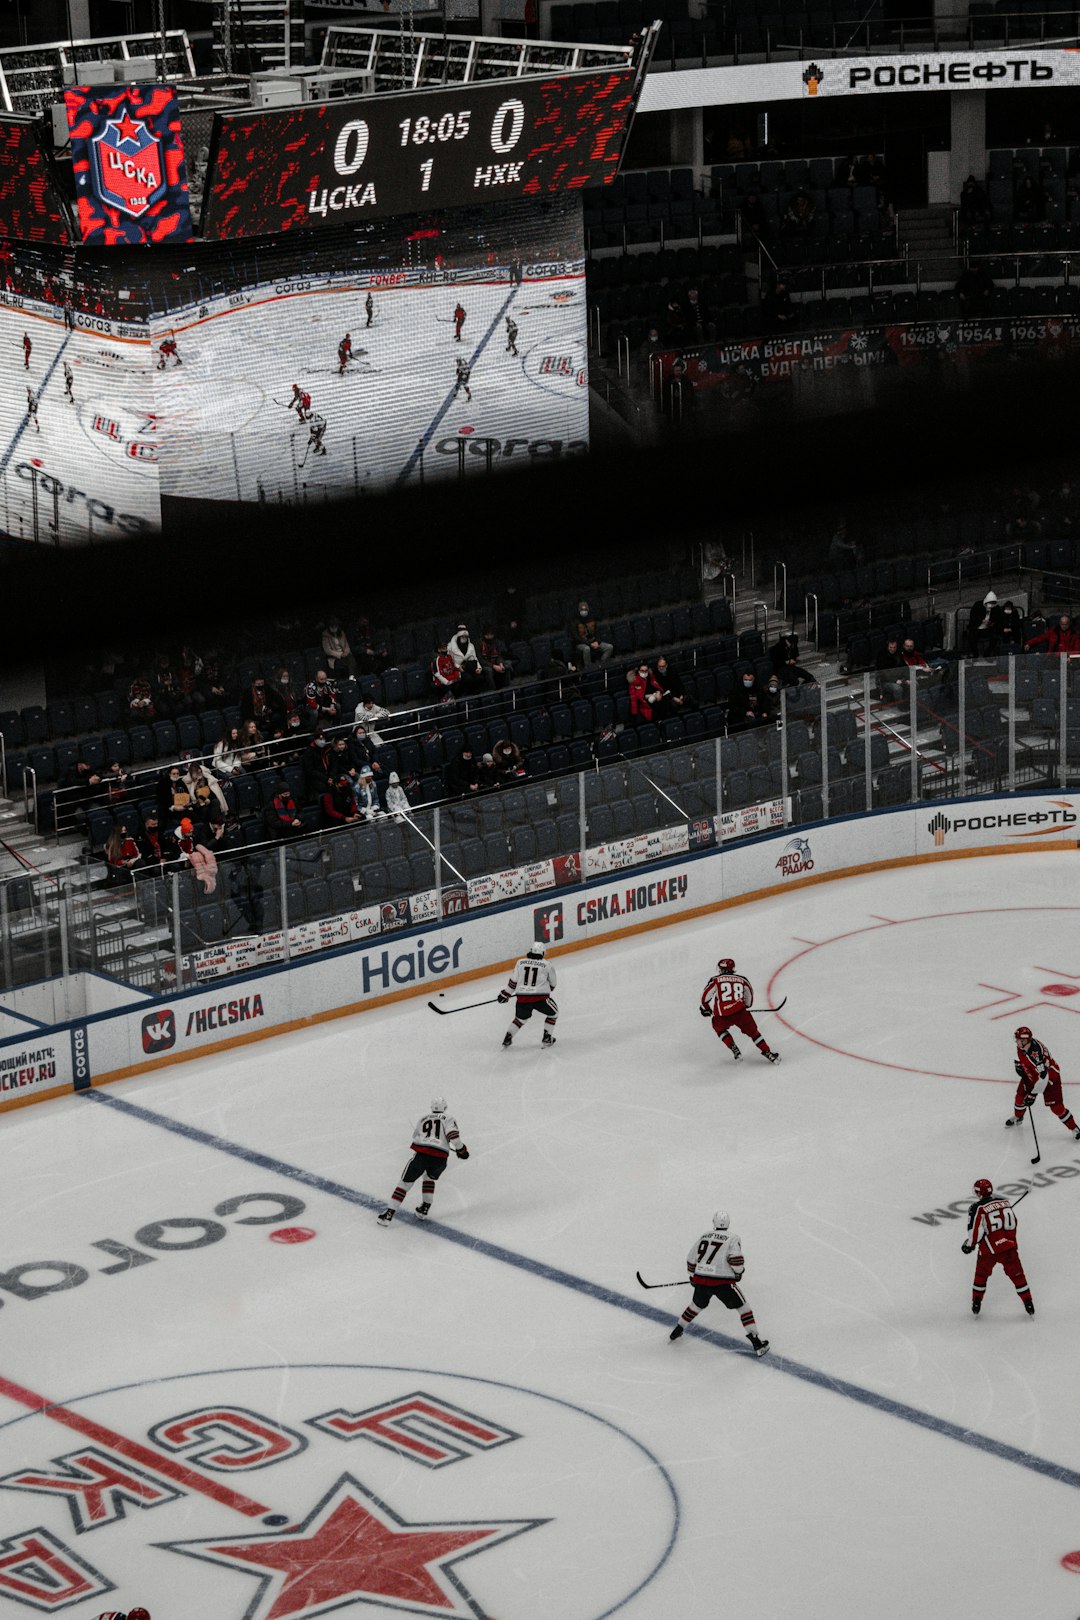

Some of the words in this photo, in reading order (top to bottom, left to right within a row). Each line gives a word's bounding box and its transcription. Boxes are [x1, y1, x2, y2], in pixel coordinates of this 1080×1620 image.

[849, 60, 1053, 88] РОСНЕФТЬ
[399, 111, 472, 146] 18:05
[490, 98, 525, 154] 0
[334, 119, 369, 176] 0
[108, 151, 159, 189] ЦСКА
[420, 158, 434, 192] 1
[473, 161, 524, 188] НХК
[308, 183, 377, 217] ЦСКА
[275, 281, 311, 294] согаз
[369, 273, 407, 286] FONBET
[0, 292, 24, 309] HL.RU
[77, 314, 111, 332] согаз
[956, 326, 994, 343] 1954
[1010, 324, 1048, 341] 1963
[900, 330, 936, 346] 1948
[720, 347, 760, 364] ЦСКА
[764, 339, 825, 359] ВСЕГДА
[760, 807, 766, 817] 11
[953, 810, 1077, 832] РОСНЕФТЬ
[776, 852, 801, 869] АВТО
[782, 858, 815, 877] РАДИО
[398, 900, 409, 915] 7
[416, 893, 431, 904] BEST
[577, 875, 689, 927] CSKA.HOCKEY
[411, 910, 437, 920] DEFENSEME
[362, 937, 464, 994] Haier
[523, 966, 538, 987] 11
[720, 981, 744, 1002] 28
[185, 994, 265, 1037] /HCCSKA
[28, 1047, 55, 1066] МАТЧ:
[73, 1028, 87, 1079] согаз
[0, 1061, 56, 1092] CKEY.RU
[422, 1119, 441, 1140] 91
[988, 1207, 1017, 1233] 50
[0, 1192, 306, 1301] сога
[697, 1240, 724, 1265] 97
[0, 1390, 524, 1615] ЦСКА
